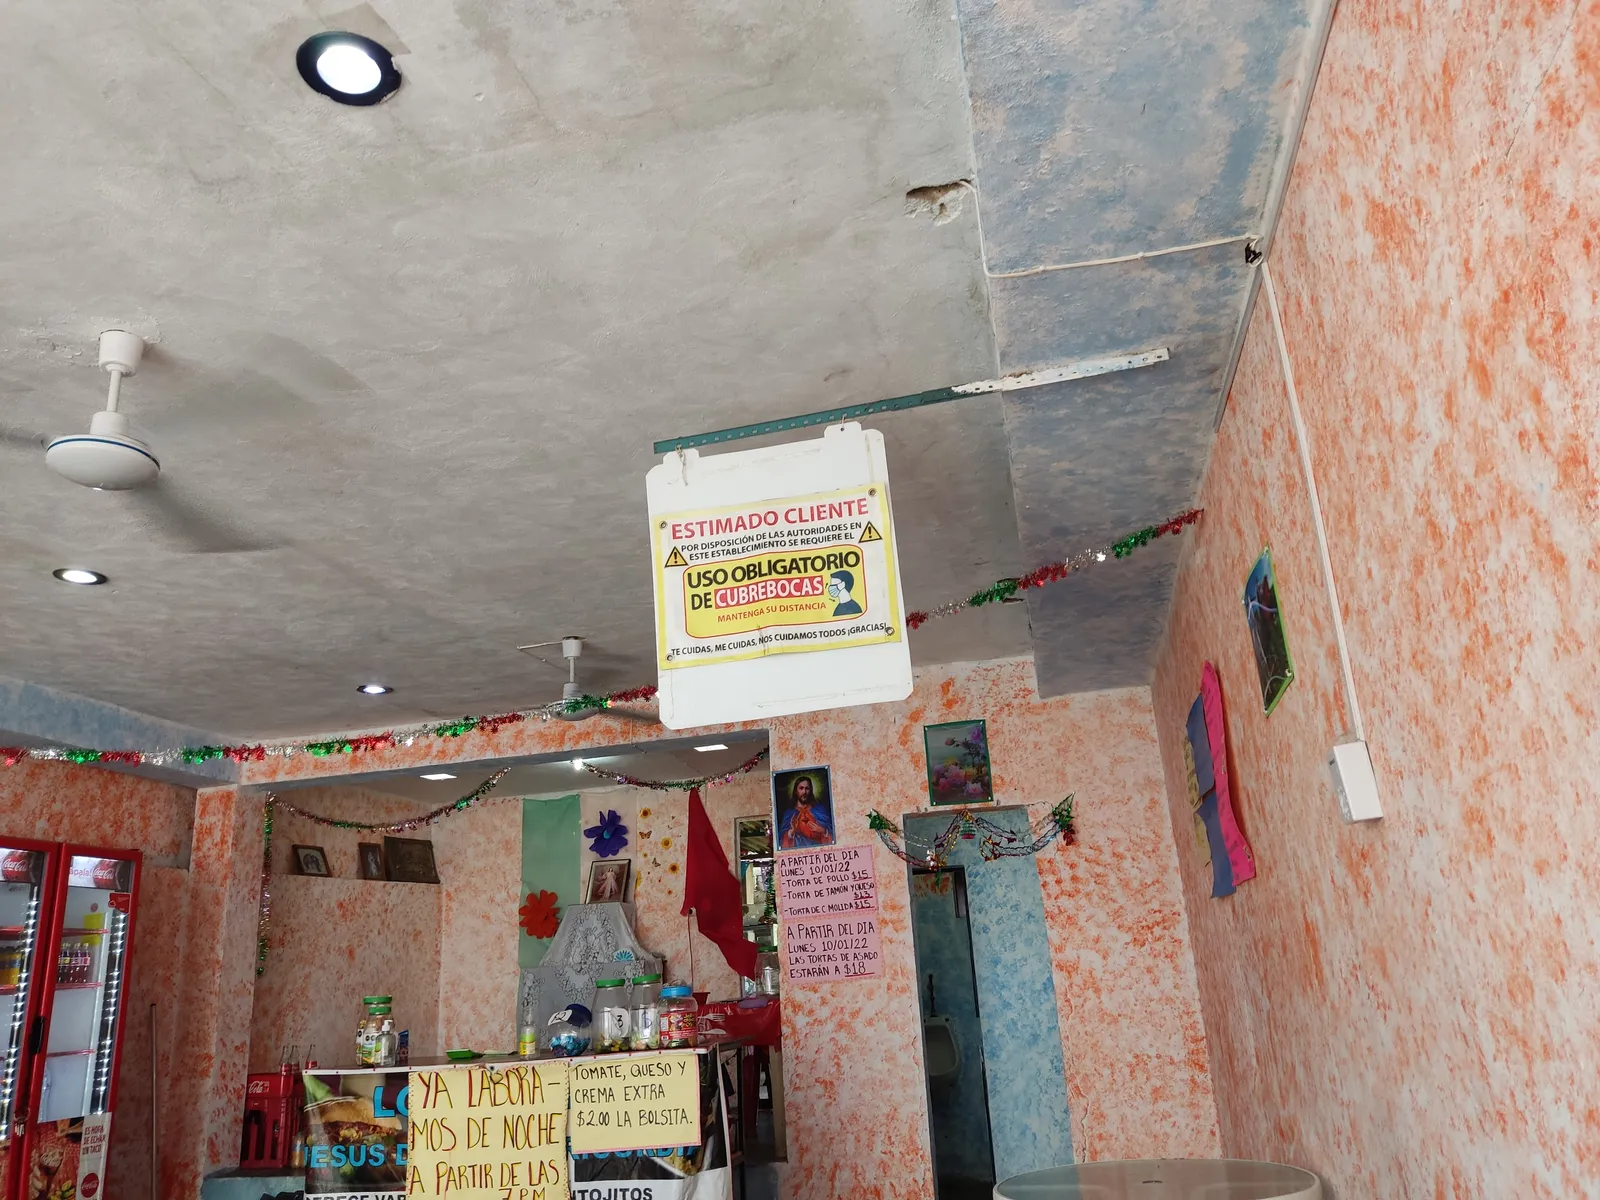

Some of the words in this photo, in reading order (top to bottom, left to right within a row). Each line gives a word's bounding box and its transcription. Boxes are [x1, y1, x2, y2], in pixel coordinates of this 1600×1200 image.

[671, 510, 779, 540] ESTIMADO
[784, 498, 869, 524] CLIENTE
[681, 543, 699, 552] POR
[701, 534, 754, 550] DISPOSICIÓN
[756, 532, 767, 540] DE
[768, 530, 785, 539] LAS
[786, 523, 848, 537] AUTORIDADES
[850, 521, 862, 530] EN
[689, 552, 709, 561] ESTE
[711, 540, 787, 558] ESTABLECIMIENTO
[788, 539, 799, 547] SE
[802, 533, 843, 545] REQUIERE
[845, 532, 855, 540] EL
[687, 568, 729, 589] USO
[731, 551, 861, 583] OBLIGATORIO
[691, 591, 712, 610] DE
[715, 576, 823, 608] CUBREBOCAS
[717, 608, 765, 623] MANTENGA
[766, 606, 778, 614] SU
[779, 602, 827, 613] DISTANCIA
[671, 648, 681, 656] TE
[682, 645, 714, 655] CUIDAS,
[714, 643, 727, 652] ME
[728, 639, 758, 650] CUIDAS,
[758, 634, 773, 645] NOS
[774, 631, 818, 641] CUIDAMOS
[819, 628, 846, 638] TODOS
[847, 622, 887, 636] ¡GRACIAS!
[780, 858, 787, 868] A
[788, 854, 821, 867] PARTIR
[823, 853, 837, 863] DEL
[842, 849, 860, 860] DIA
[780, 867, 804, 877] LUNES
[809, 860, 850, 875] 10/01/22
[814, 877, 823, 885] DE
[826, 873, 849, 883] POLLO
[851, 869, 869, 880] $15
[814, 889, 824, 898] DE
[811, 905, 820, 914] DE
[821, 905, 826, 914] C
[828, 902, 854, 912] MOLIDA
[854, 899, 871, 909] $15
[787, 925, 795, 940] A
[797, 923, 834, 939] PARTIR
[838, 923, 854, 936] DEL
[857, 921, 875, 935] DIA
[787, 942, 816, 954] LUNES
[822, 937, 868, 952] 10/01/22
[789, 955, 805, 966] LAS
[807, 953, 838, 964] TORTAS
[840, 952, 850, 962] DE
[853, 951, 878, 961] ASADO
[790, 964, 830, 979] ESTARÁN
[834, 965, 841, 975] A
[844, 961, 867, 976] $18
[573, 1064, 626, 1081] TOMATE,
[630, 1062, 672, 1077] QUESO
[677, 1061, 686, 1076] Y
[418, 1071, 453, 1109] YA
[574, 1087, 615, 1103] CREMA
[624, 1084, 665, 1101] EXTRA
[576, 1110, 610, 1127] $2.00
[616, 1110, 632, 1128] LA
[638, 1108, 693, 1126] BOLSITA.
[410, 1117, 457, 1151] MOS
[467, 1117, 492, 1149] DE
[503, 1113, 562, 1150] NOCHE
[408, 1165, 425, 1195] A
[436, 1161, 493, 1195] PARTIR
[500, 1162, 522, 1188] DE
[528, 1159, 560, 1187] LAS
